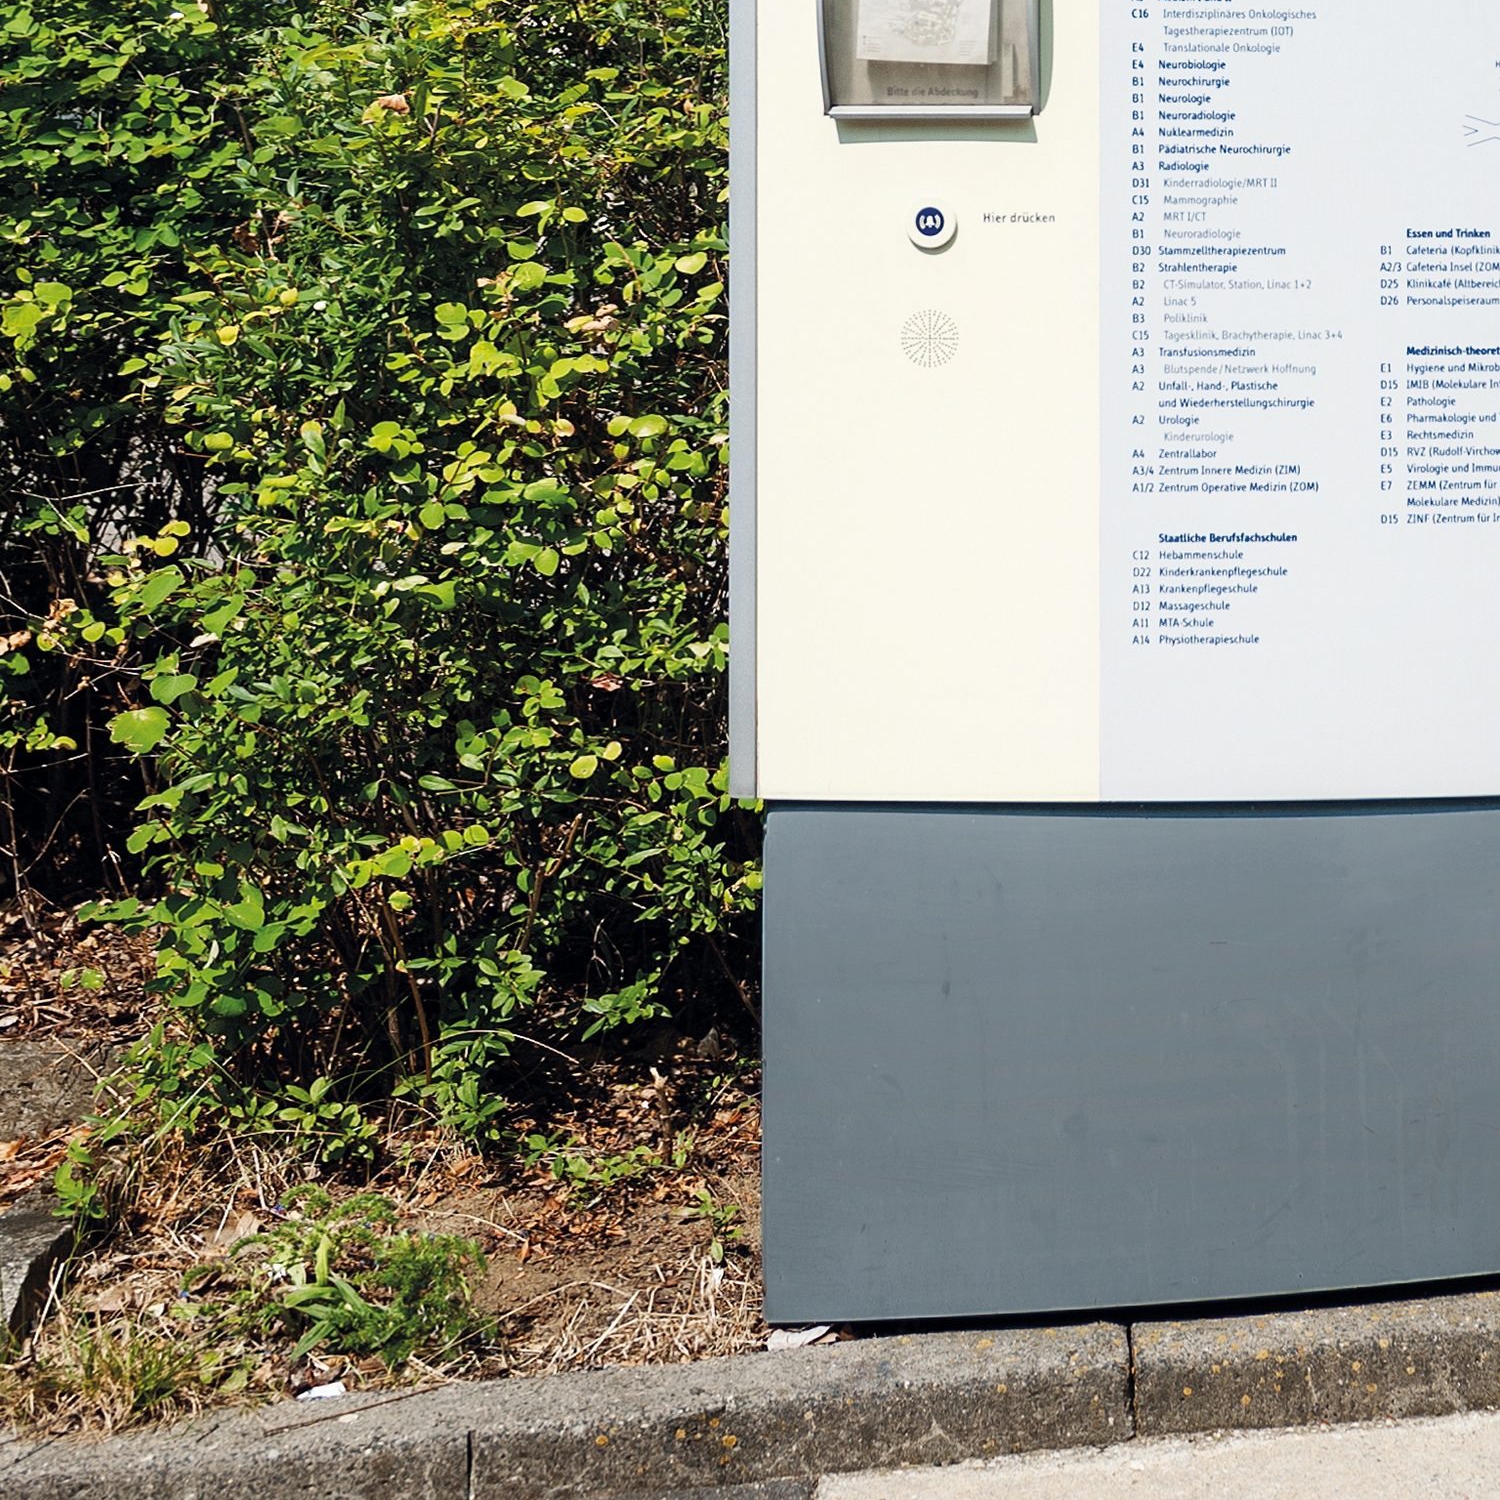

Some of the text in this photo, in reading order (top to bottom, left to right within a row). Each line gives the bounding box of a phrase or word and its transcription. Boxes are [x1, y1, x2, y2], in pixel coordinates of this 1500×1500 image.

[887, 86, 909, 97] Bitte
[928, 86, 979, 99] Abdeckung
[1131, 93, 1211, 106] B1 Neurologie
[1131, 127, 1233, 137] A4 Nuklearmedizin
[1131, 161, 1209, 173] A3 Radiologie
[982, 212, 1055, 223] Hier drücken
[1406, 228, 1490, 238] Essen und Trinken
[1380, 245, 1391, 255] B1
[1405, 245, 1447, 255] Cafeteria
[1380, 396, 1456, 408] E2 Pathologie
[1158, 532, 1297, 543] Staatliche Berufsfachschulen
[1131, 634, 1259, 646] A14 Physiotherapieschule
